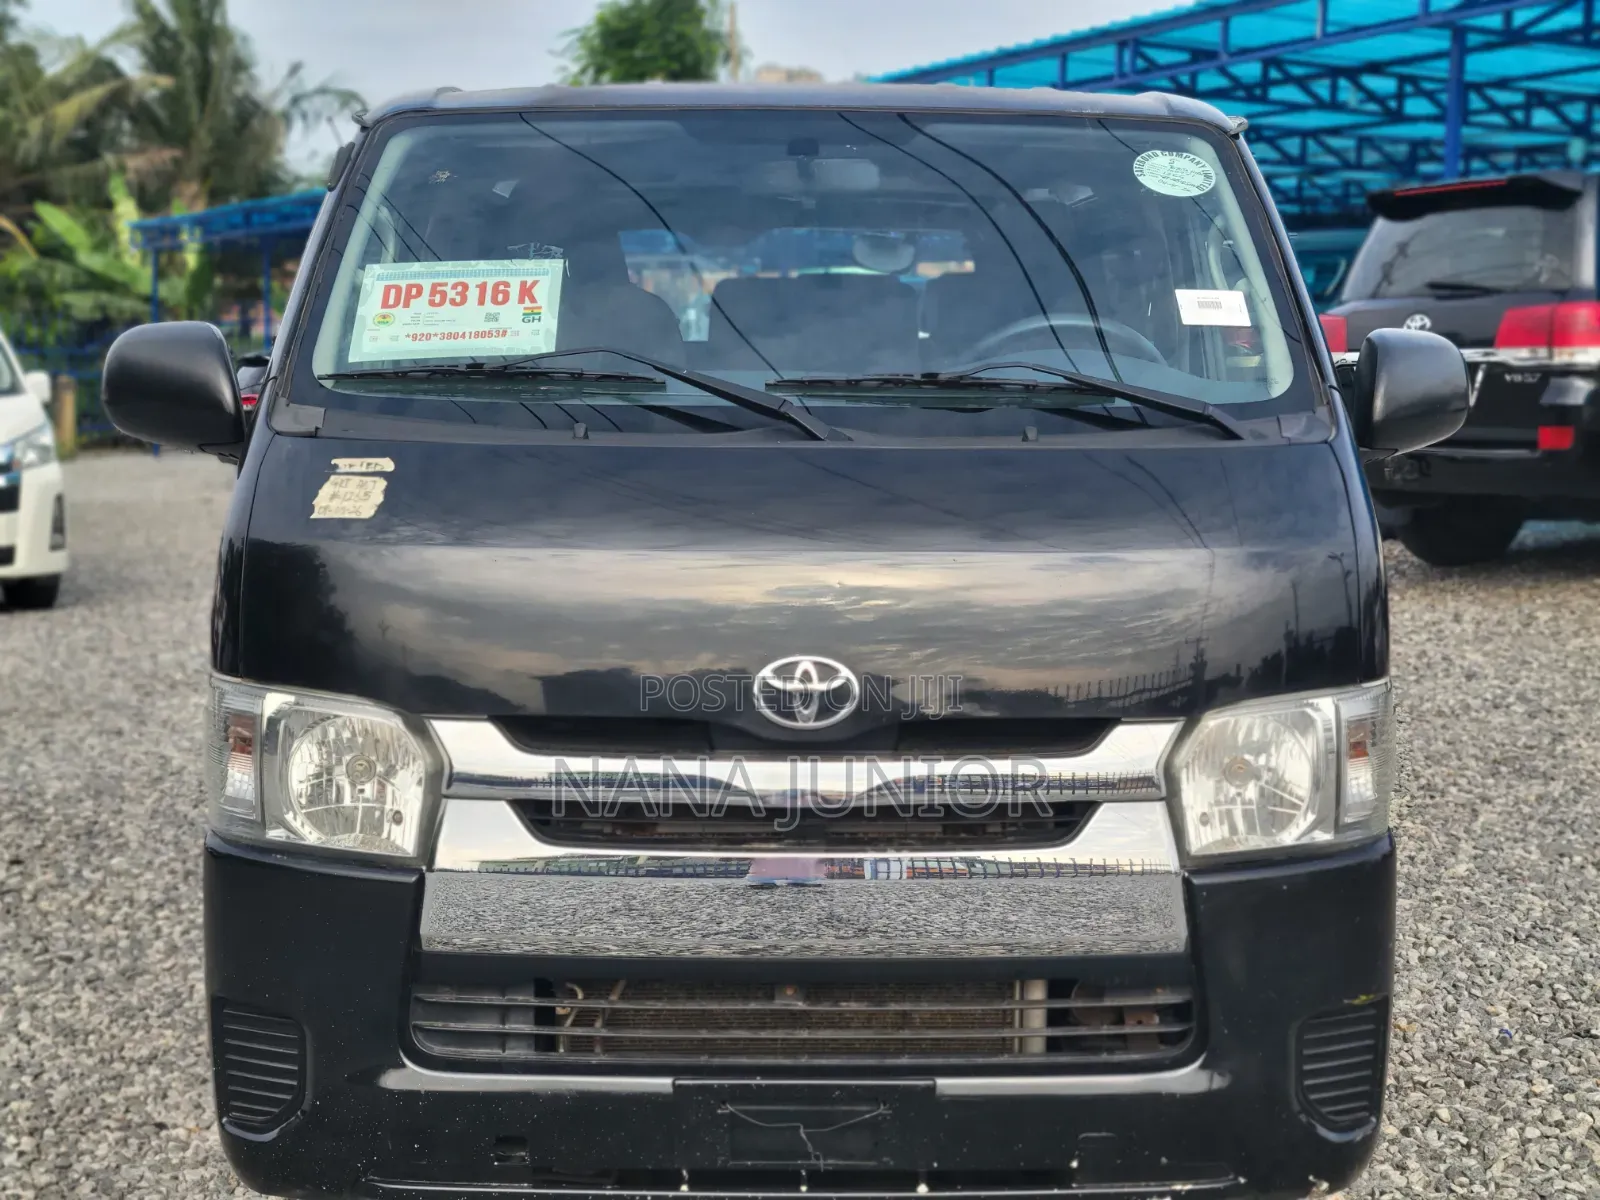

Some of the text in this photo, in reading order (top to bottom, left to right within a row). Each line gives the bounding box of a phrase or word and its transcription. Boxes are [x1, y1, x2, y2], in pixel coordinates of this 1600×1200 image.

[1134, 151, 1159, 177] SAFEBOND
[1160, 151, 1207, 169] COMPANY
[1196, 169, 1214, 192] LIMITED
[380, 283, 424, 310] DP
[517, 279, 541, 305] K
[521, 315, 542, 324] GH
